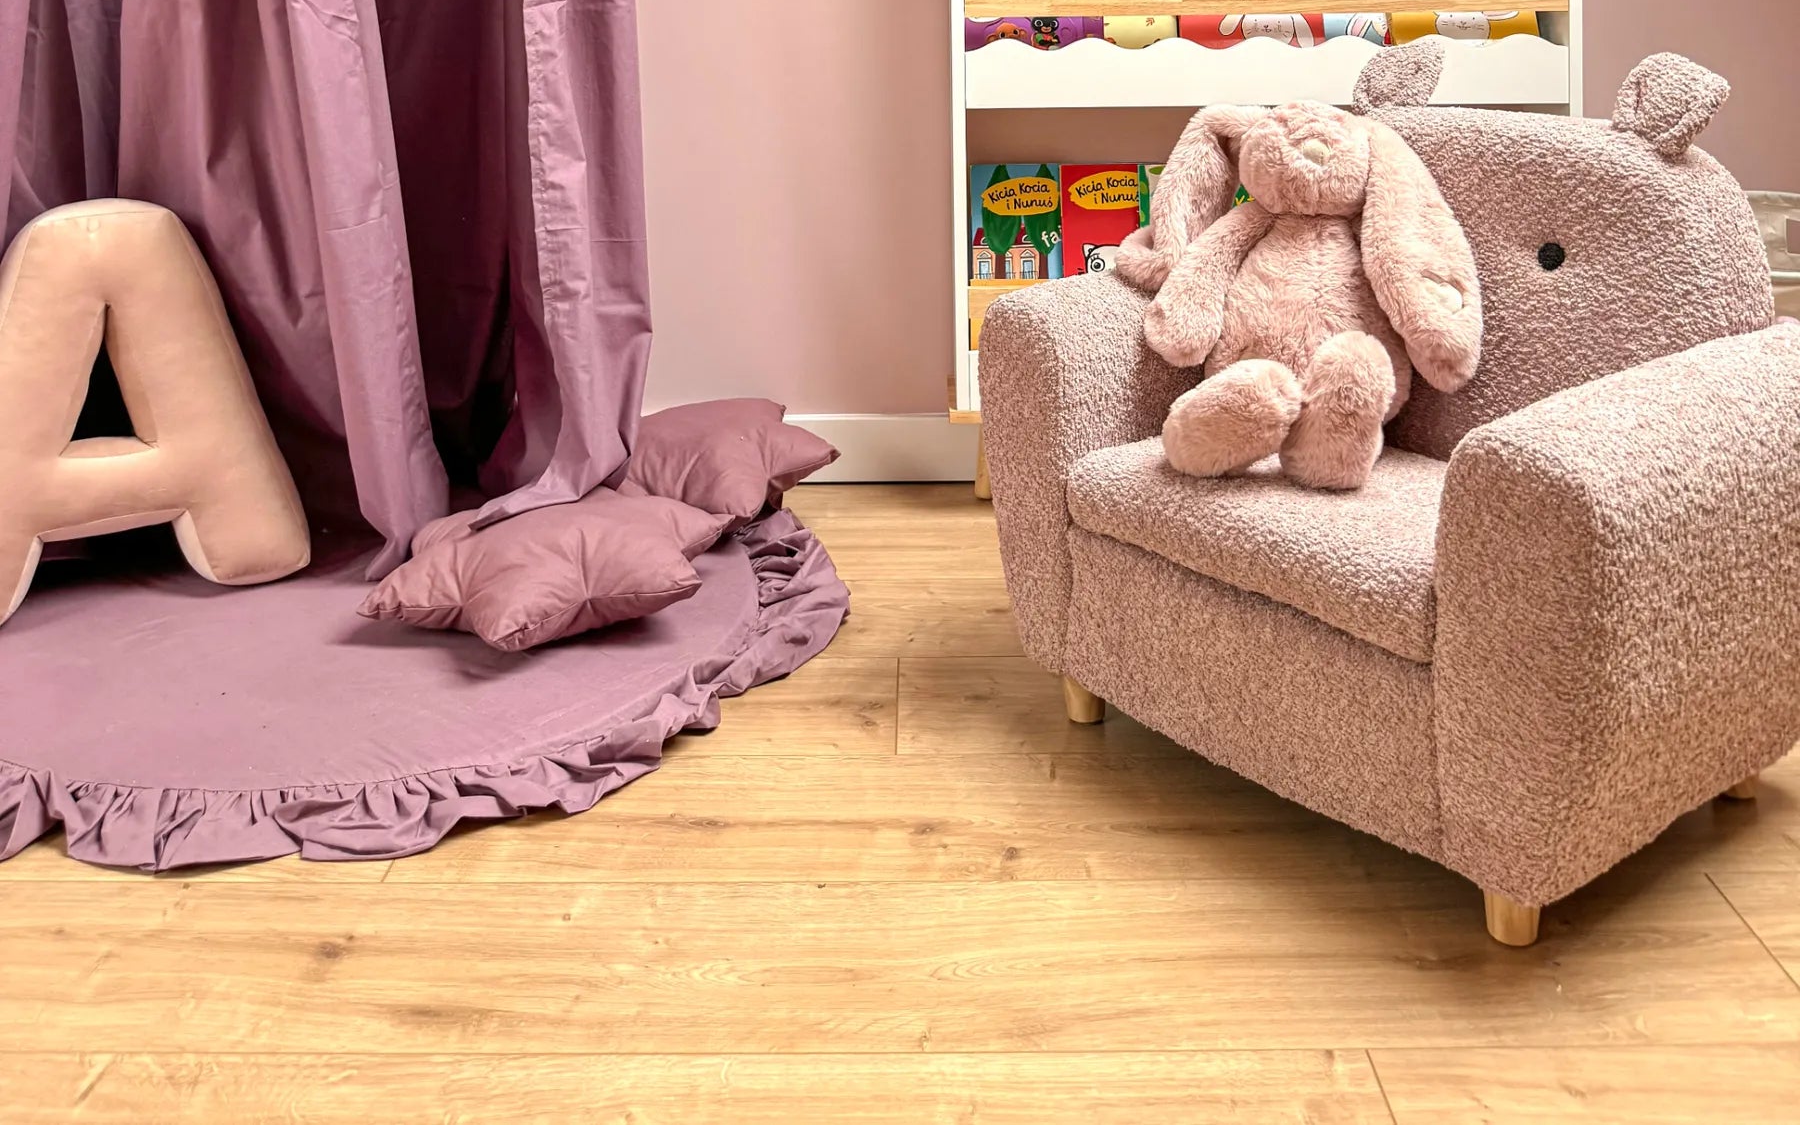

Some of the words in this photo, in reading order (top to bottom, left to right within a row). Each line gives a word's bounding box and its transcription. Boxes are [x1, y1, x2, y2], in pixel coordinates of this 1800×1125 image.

[988, 187, 1017, 204] Kicia
[1019, 181, 1050, 194] Kocia
[1076, 181, 1104, 198] Kicia
[1106, 176, 1138, 188] Kocia
[1006, 199, 1010, 210] i
[1014, 197, 1053, 210] Nunuś
[1094, 194, 1097, 204] i
[1041, 225, 1061, 248] fa
[0, 198, 311, 627] A
